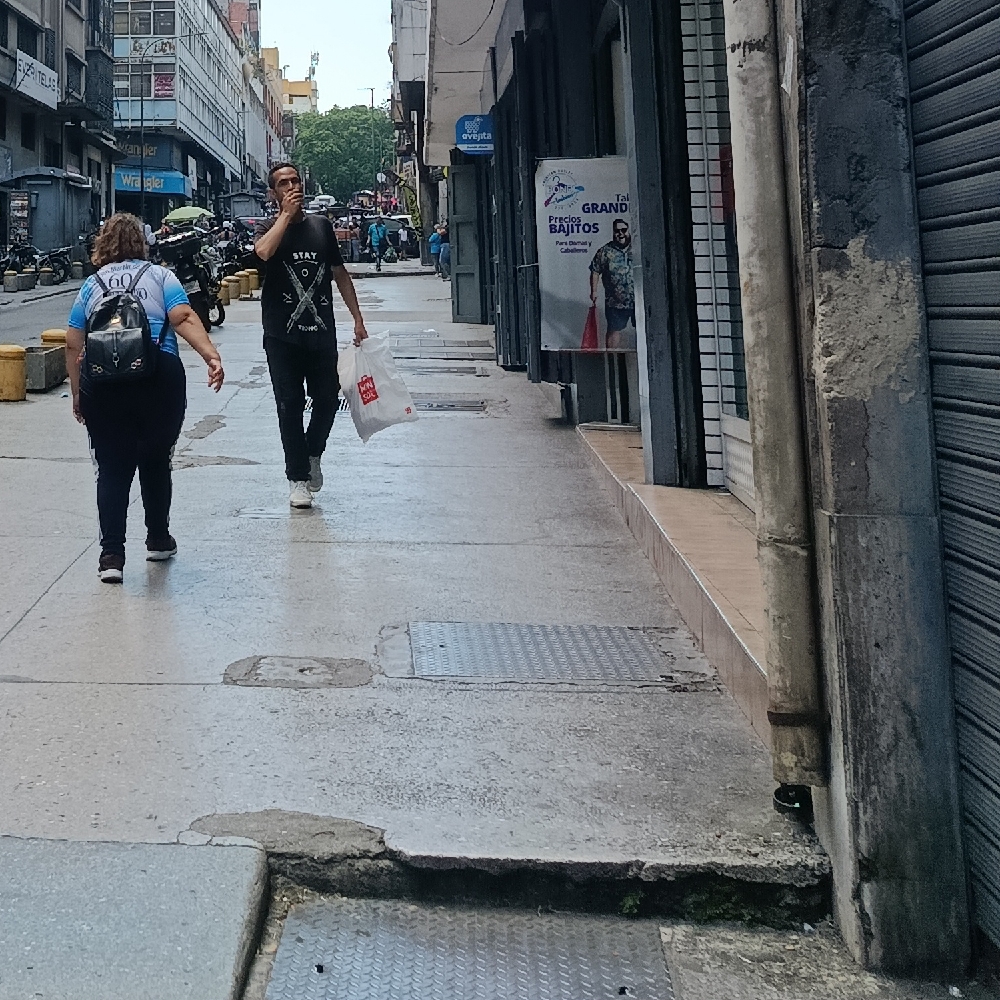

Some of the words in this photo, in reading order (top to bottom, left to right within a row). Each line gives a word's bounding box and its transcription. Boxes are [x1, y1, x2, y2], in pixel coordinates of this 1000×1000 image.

[582, 203, 628, 213] GRAND
[549, 215, 582, 223] Precios
[549, 223, 600, 236] BAJITOS
[292, 251, 318, 260] STAY
